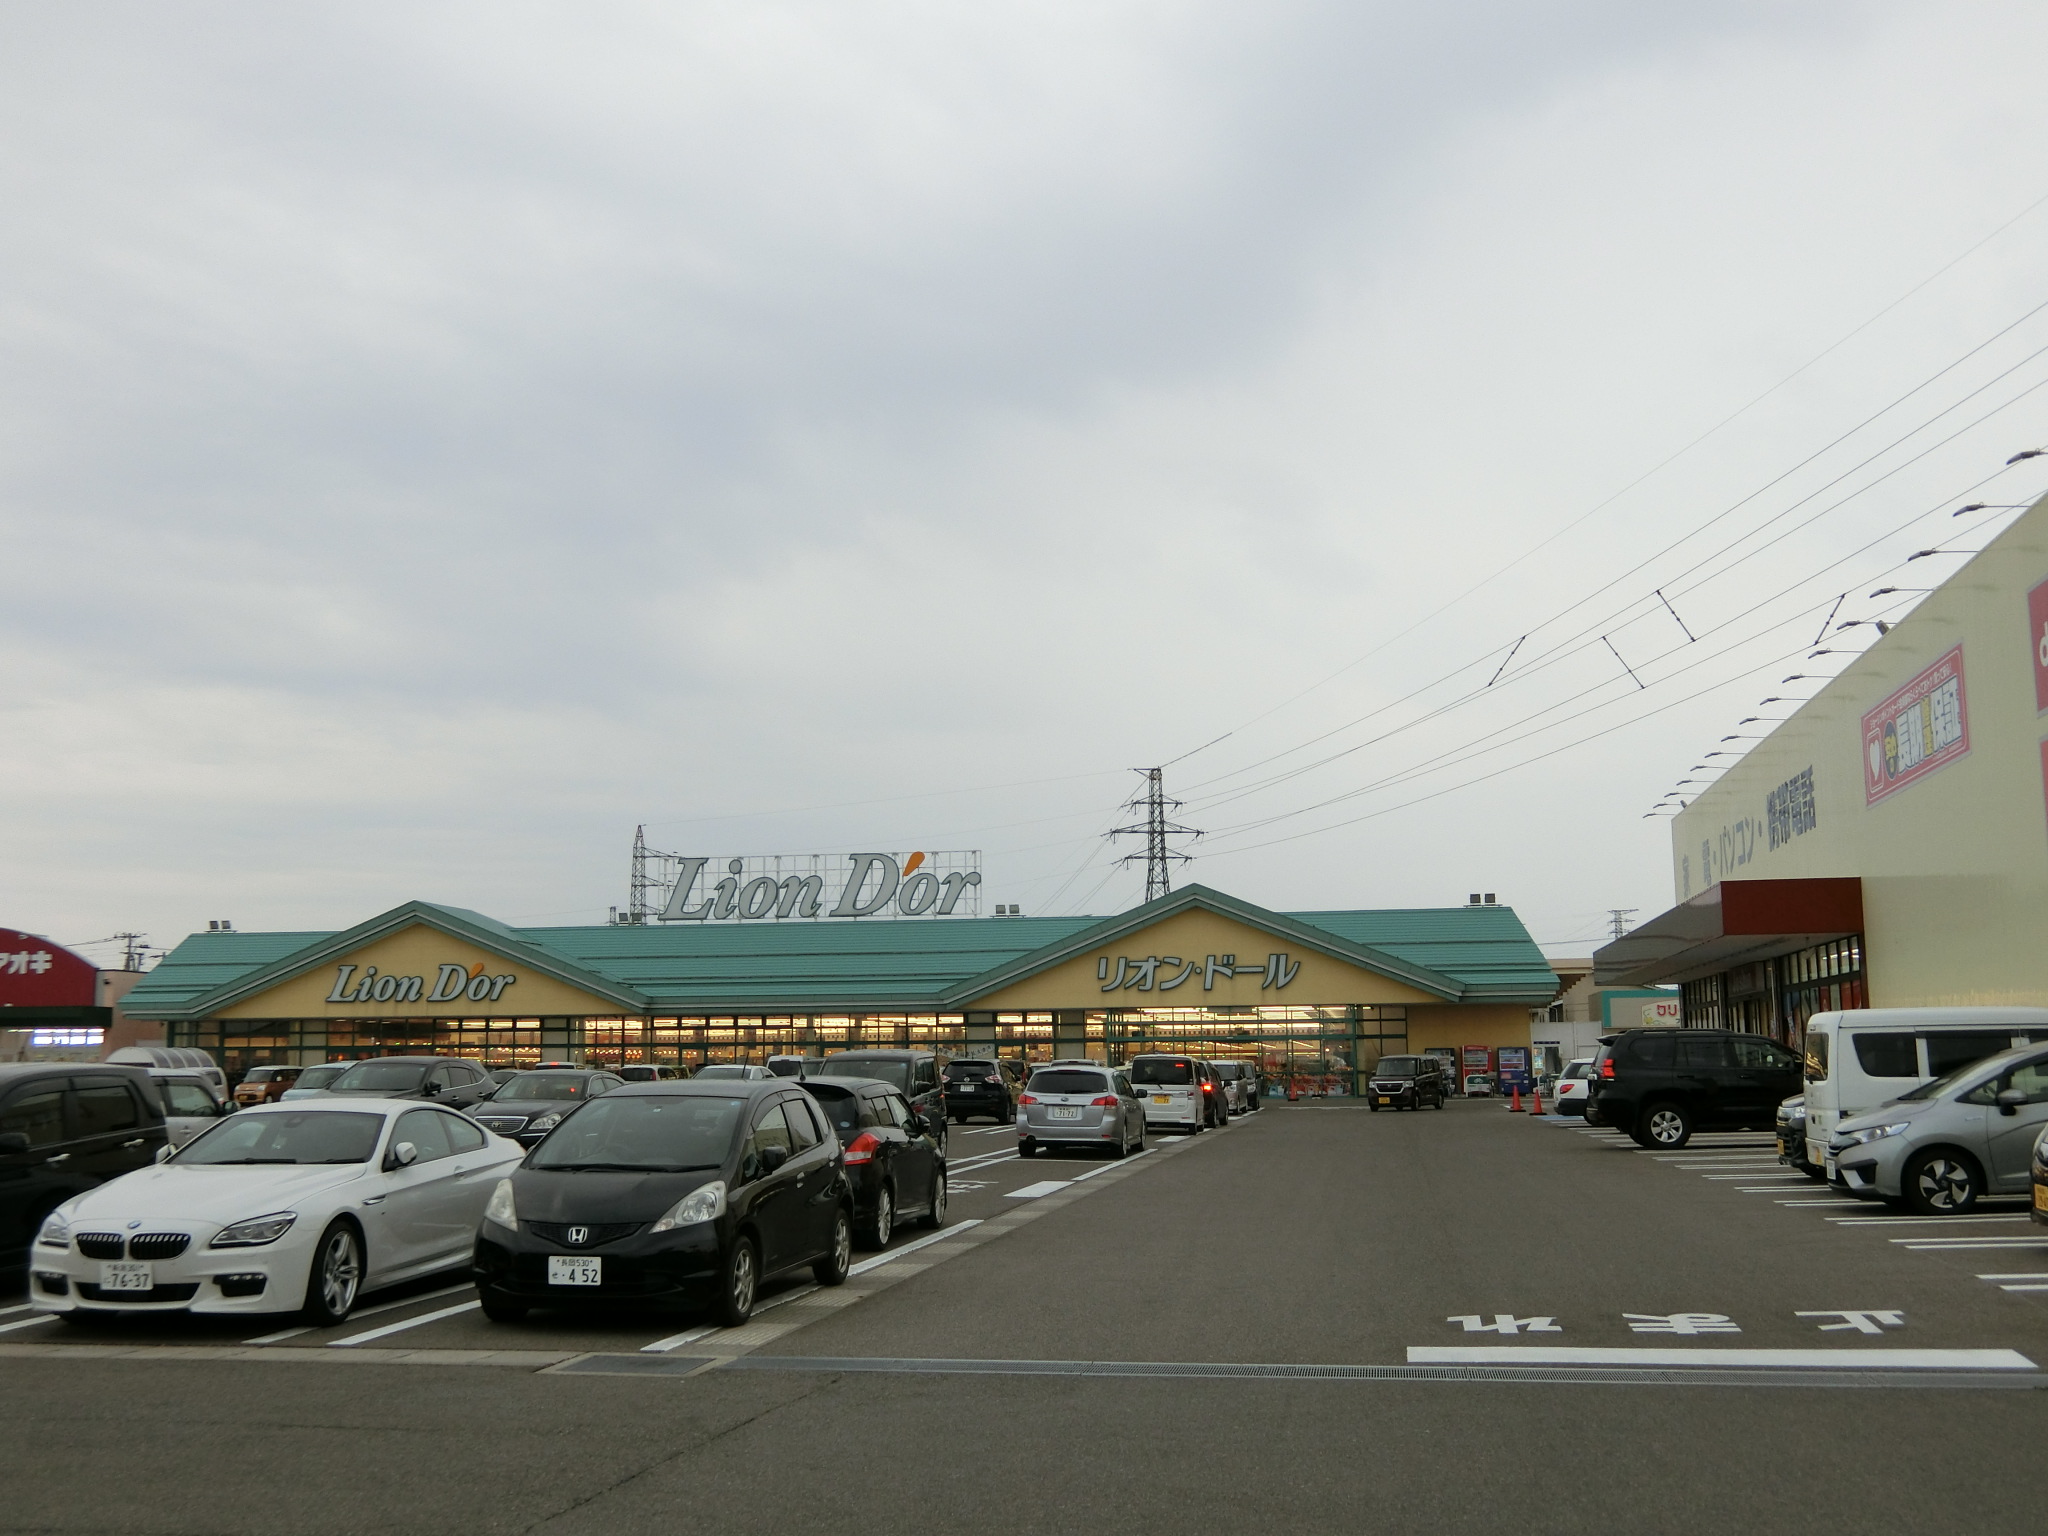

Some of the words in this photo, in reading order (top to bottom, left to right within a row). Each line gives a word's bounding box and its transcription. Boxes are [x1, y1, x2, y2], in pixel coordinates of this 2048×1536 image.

[657, 857, 823, 920] Lion
[325, 964, 424, 1003] Lion
[1097, 953, 1301, 992] リオン・ドール
